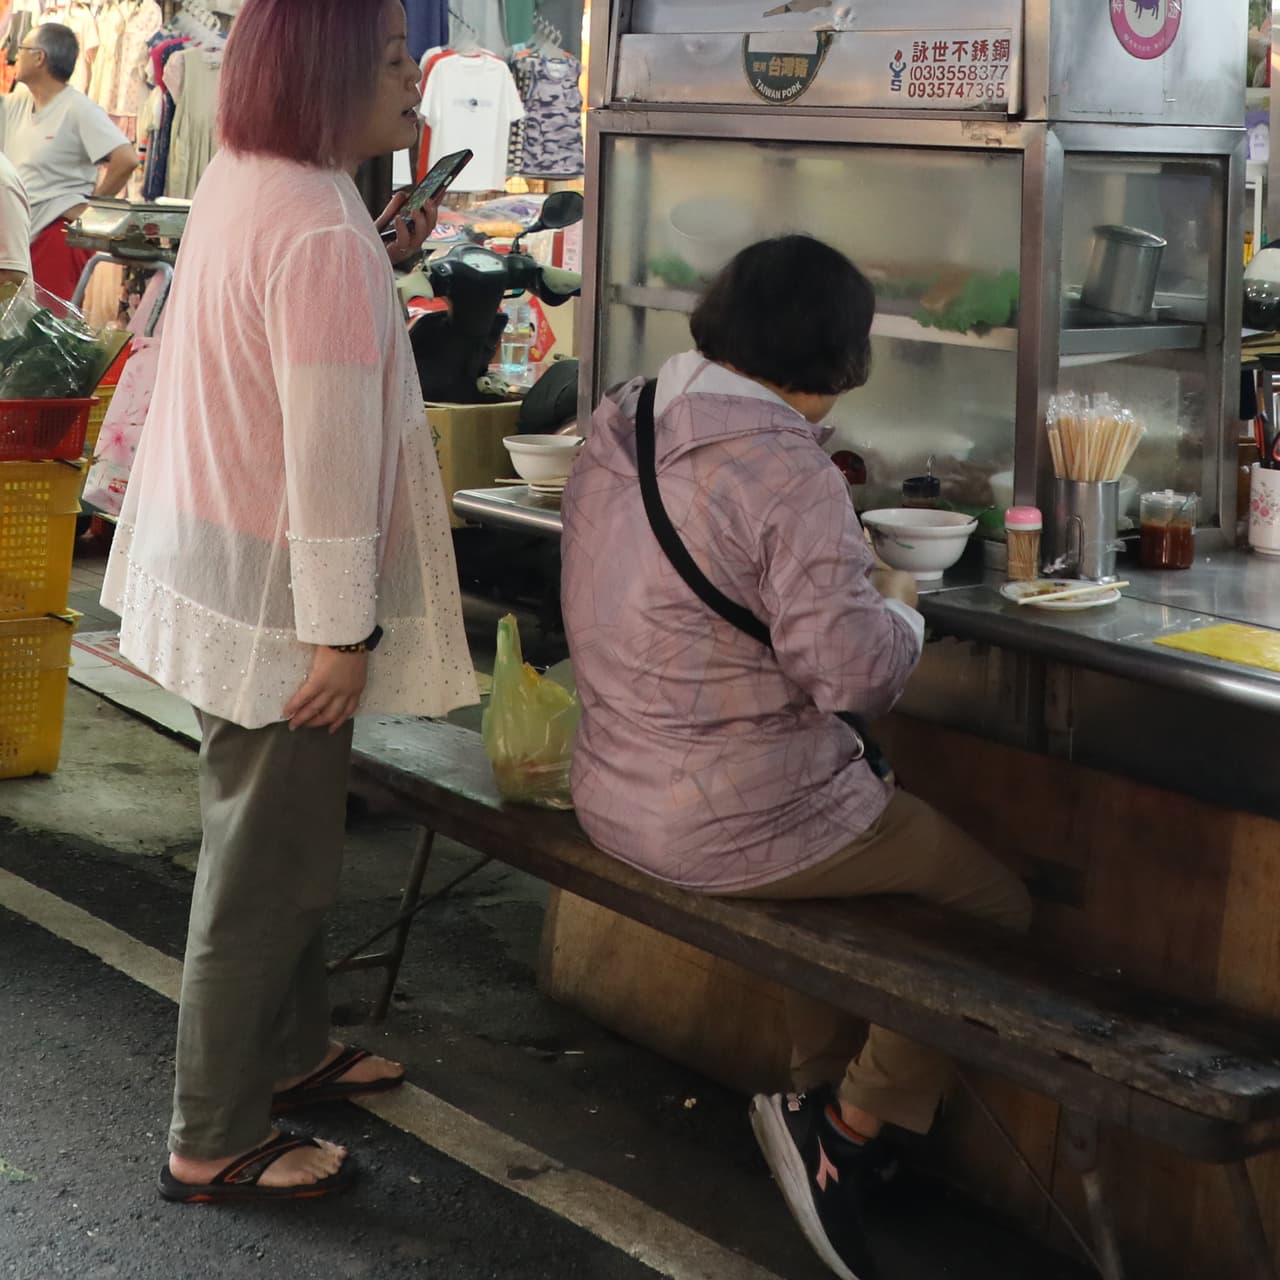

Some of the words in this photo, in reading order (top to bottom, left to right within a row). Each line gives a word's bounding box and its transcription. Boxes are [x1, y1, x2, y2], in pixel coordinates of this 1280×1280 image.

[910, 65, 1009, 81] (03)3558377
[755, 79, 781, 99] TAIWAN
[782, 80, 803, 99] PORK
[908, 82, 1006, 98] 0935747365
